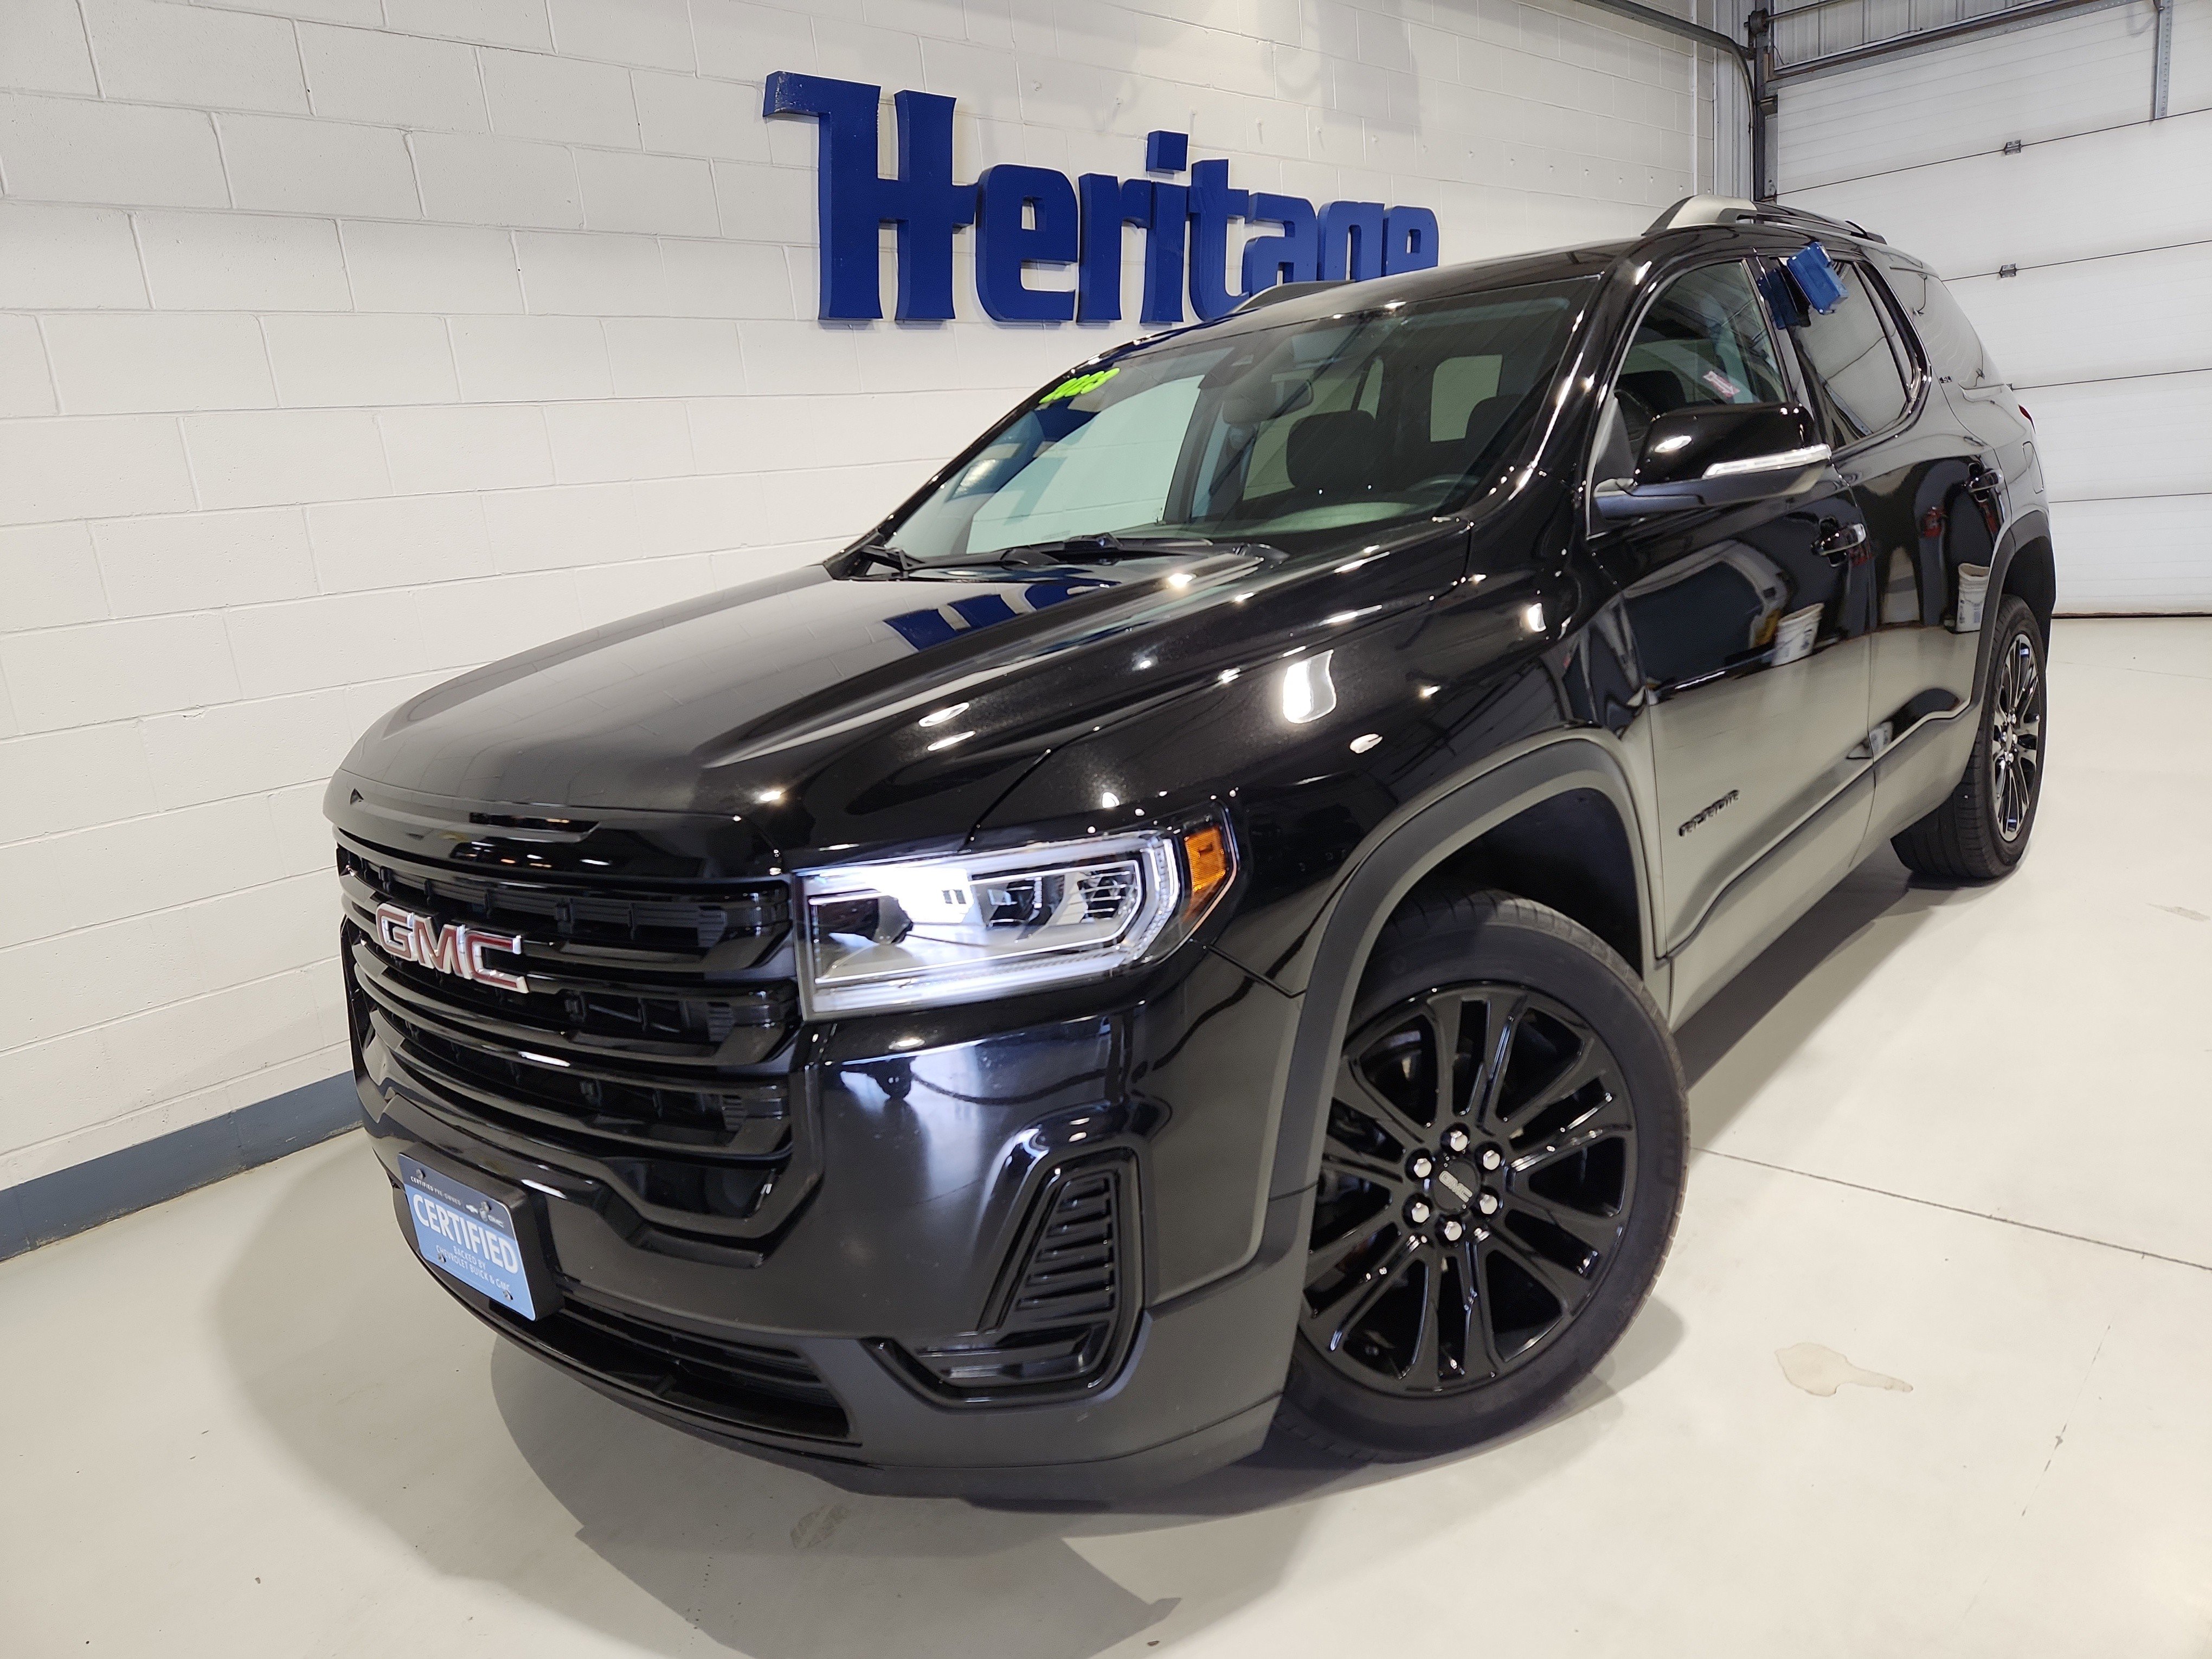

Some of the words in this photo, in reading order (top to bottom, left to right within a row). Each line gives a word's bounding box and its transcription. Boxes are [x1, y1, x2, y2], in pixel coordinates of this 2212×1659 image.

[376, 903, 529, 994] GMC
[1439, 1170, 1473, 1203] GMC
[413, 1194, 518, 1274] CERTIFIED
[436, 1245, 468, 1270] CHEVROLET
[470, 1264, 488, 1281] BUICK
[453, 1245, 477, 1265] BACKED
[477, 1259, 486, 1270] BY
